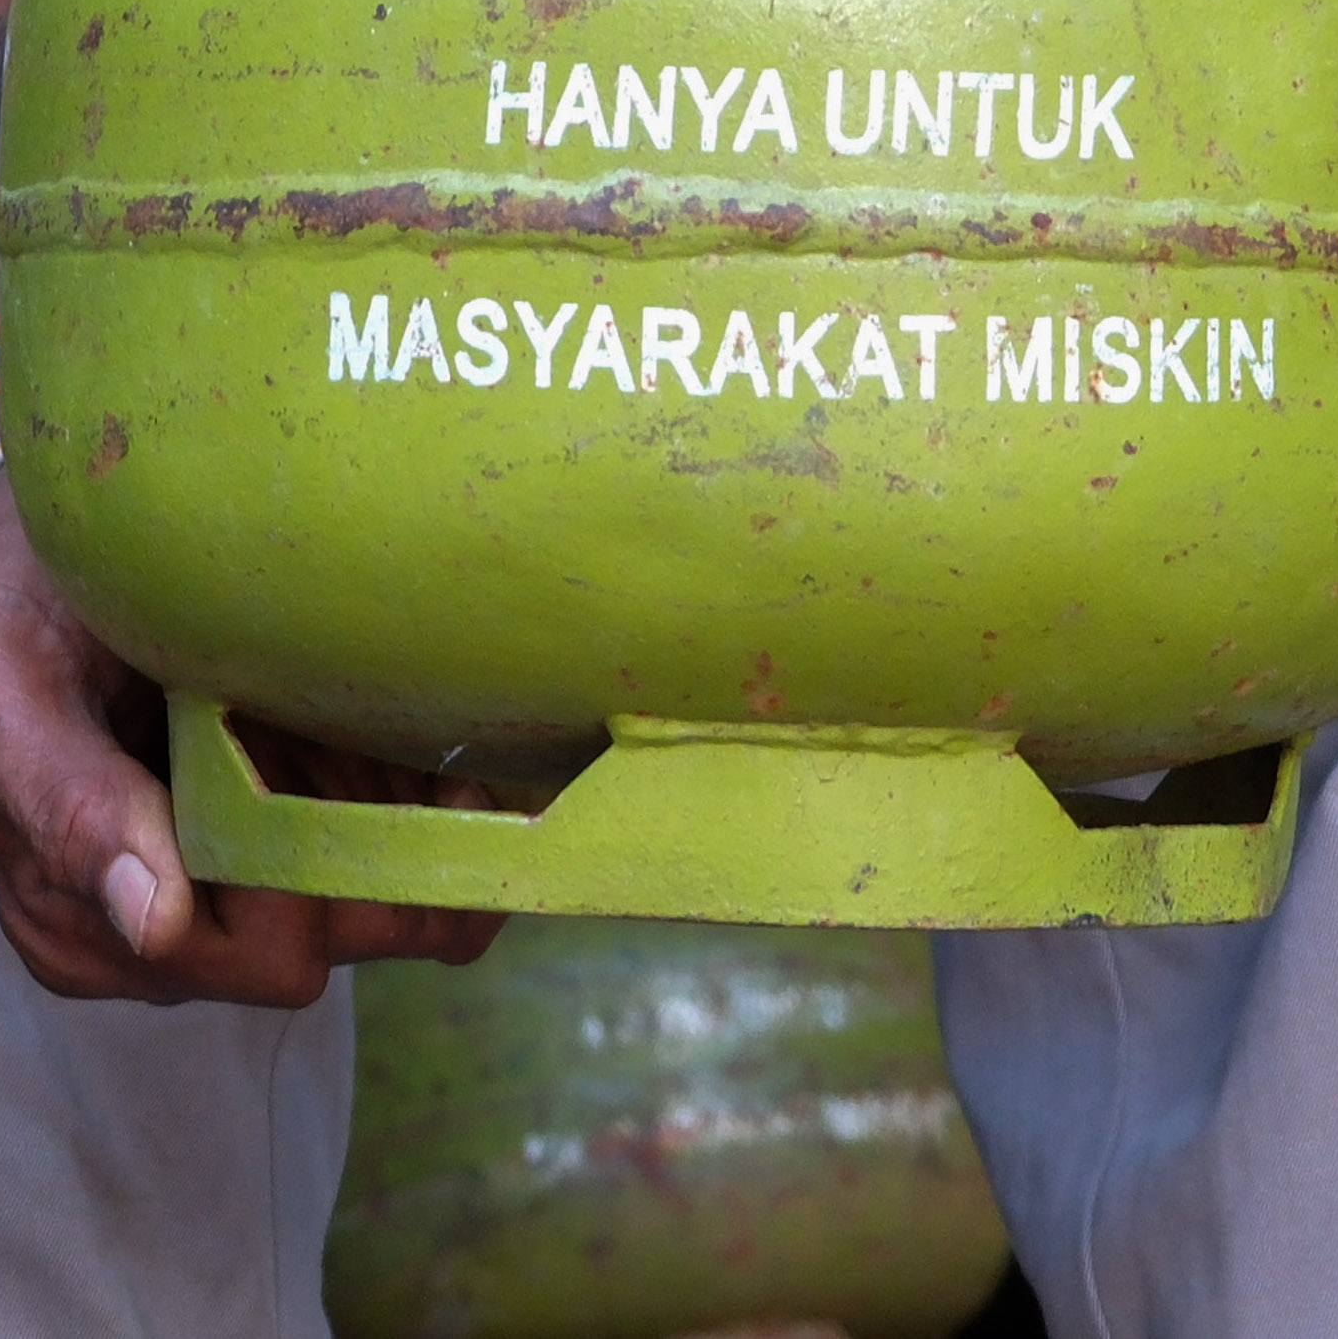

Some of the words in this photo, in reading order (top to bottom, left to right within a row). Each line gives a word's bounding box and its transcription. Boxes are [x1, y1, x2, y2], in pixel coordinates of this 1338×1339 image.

[483, 59, 799, 154] HANYA
[824, 68, 1136, 164] UNTUK
[326, 290, 958, 403] MASYARAKAT
[984, 315, 1277, 405] MISKIN
